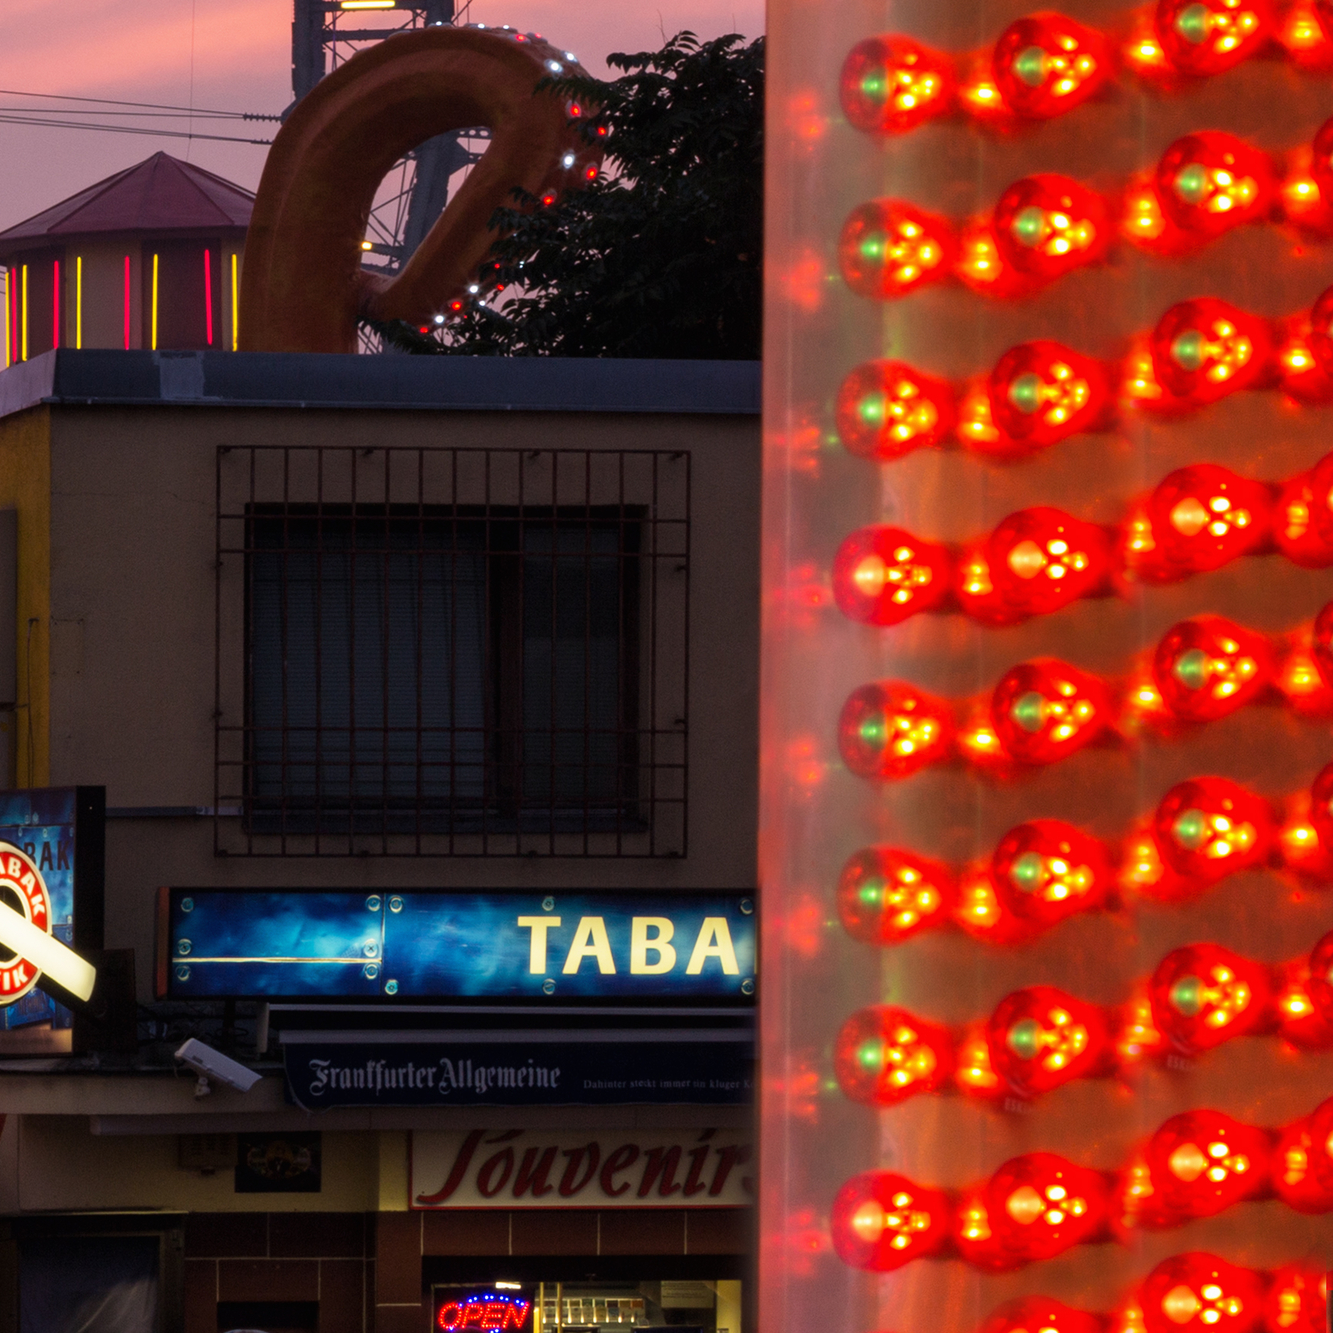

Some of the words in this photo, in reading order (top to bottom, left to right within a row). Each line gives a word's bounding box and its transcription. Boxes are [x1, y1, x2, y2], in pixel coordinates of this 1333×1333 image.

[517, 916, 757, 975] TABA
[308, 1059, 438, 1097] Frankfurter
[438, 1057, 561, 1095] Allgemeine
[583, 1079, 626, 1089] Dahinter
[660, 1079, 691, 1088] immer
[709, 1079, 739, 1091] kluger
[437, 1301, 530, 1330] OPEN
